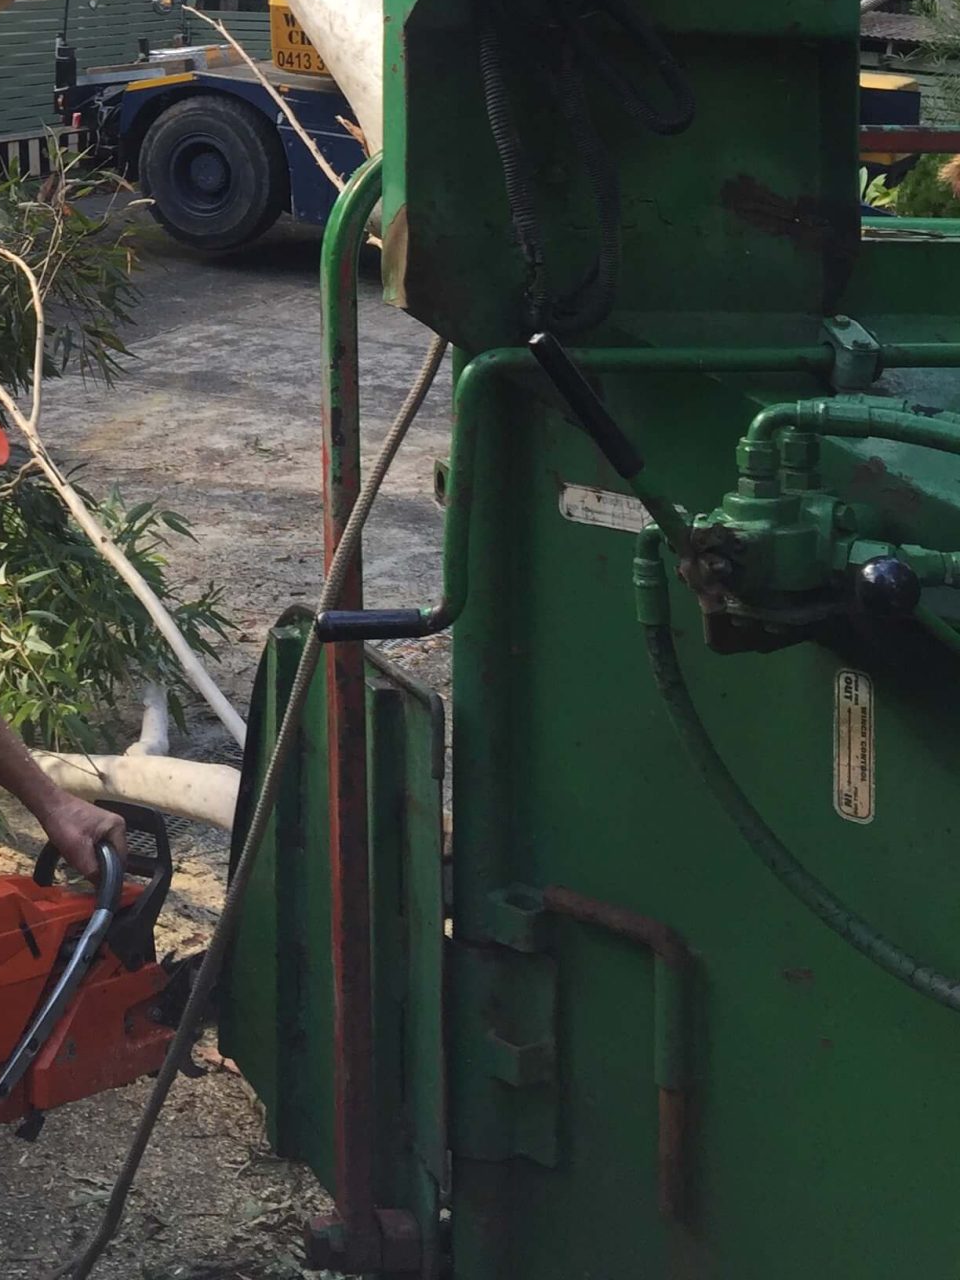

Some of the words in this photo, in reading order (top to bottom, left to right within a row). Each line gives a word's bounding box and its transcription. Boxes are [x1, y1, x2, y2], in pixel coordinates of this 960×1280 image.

[277, 50, 312, 70] 0413
[317, 54, 325, 71] 3
[844, 675, 853, 702] OUT
[844, 793, 853, 808] IN
